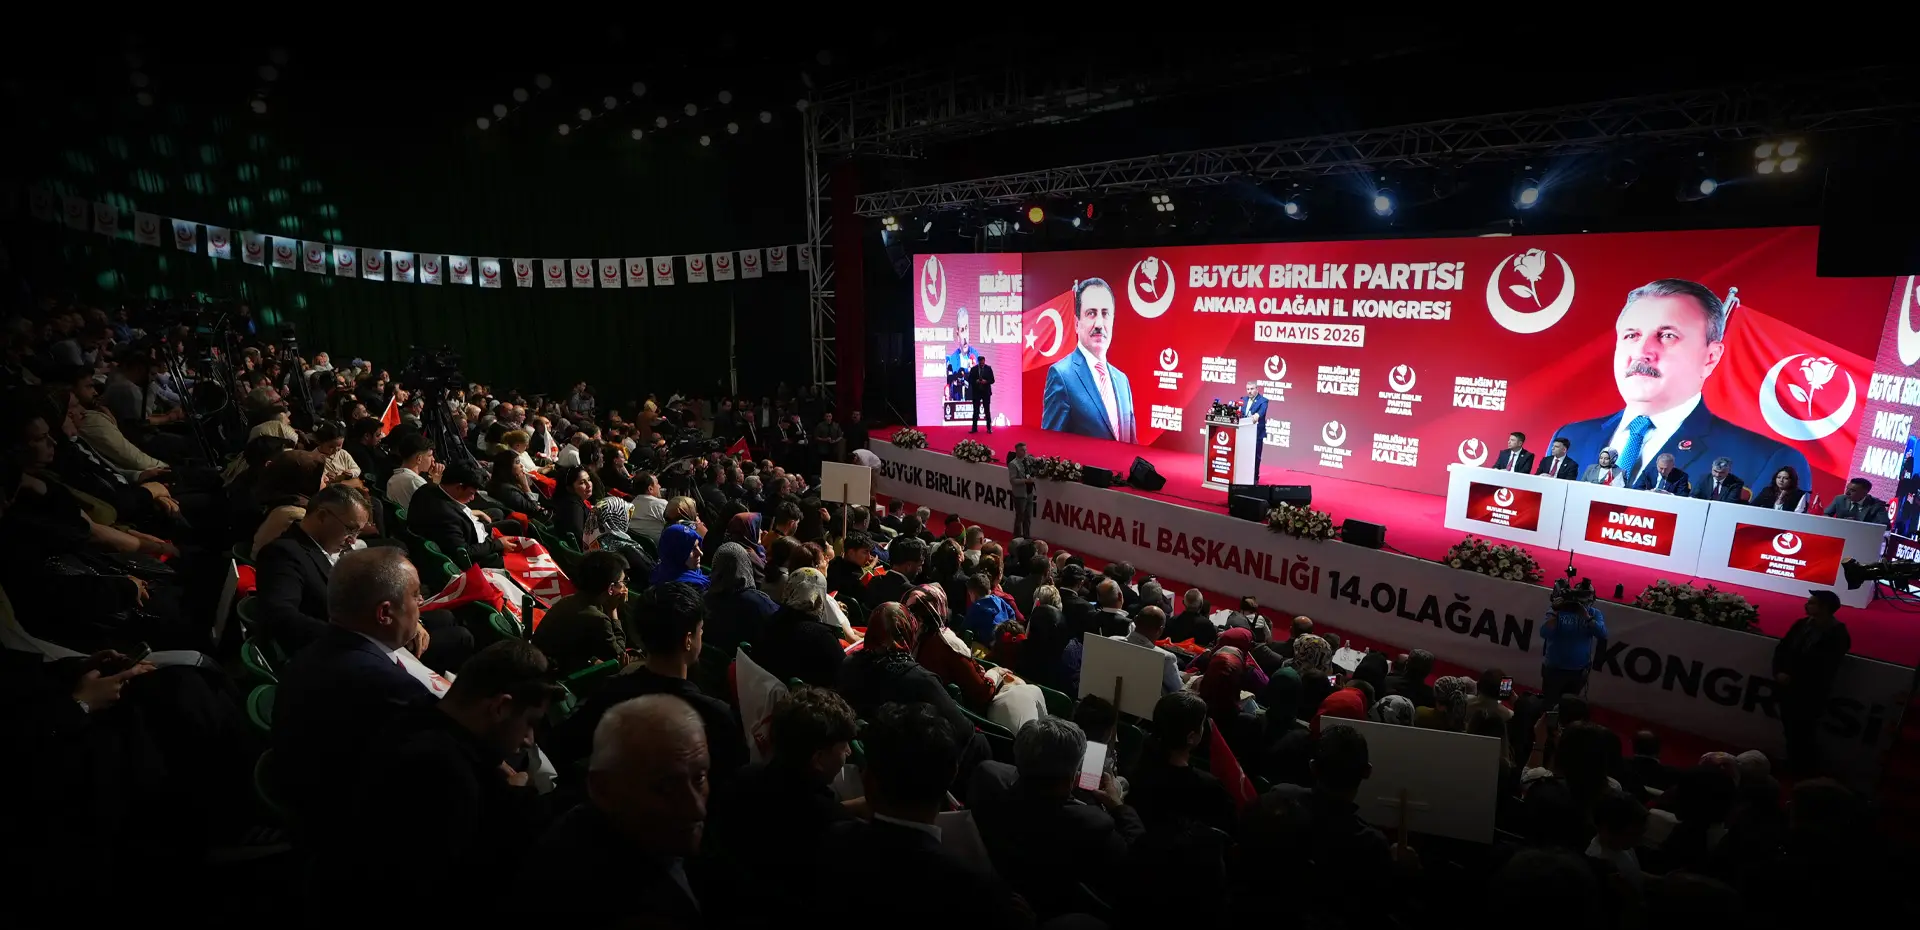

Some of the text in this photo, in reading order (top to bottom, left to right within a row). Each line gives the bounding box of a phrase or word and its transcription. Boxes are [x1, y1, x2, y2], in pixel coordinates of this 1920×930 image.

[1189, 262, 1465, 290] BÜYÜK BİRLİK PARTİSİ
[1193, 294, 1452, 320] ANKARA OLAĞAN İL KONGRESİ
[1259, 325, 1360, 342] 10 MAYIS 2026
[1316, 380, 1359, 396] KALESİ
[1494, 379, 1507, 389] VE
[1452, 393, 1506, 411] KALESİ
[1371, 448, 1418, 467] KALESİ
[1608, 511, 1655, 530] DİVAN
[1600, 527, 1657, 547] MASASI
[879, 458, 923, 487] BÜYÜK
[926, 471, 972, 500] BİRLİK
[975, 486, 1037, 518] PARTİ
[1040, 498, 1127, 543] ANKARA
[1132, 520, 1151, 549] İL
[1156, 527, 1320, 595] BAŞKANLIĞI
[1592, 641, 1886, 745] KONGRSİ
